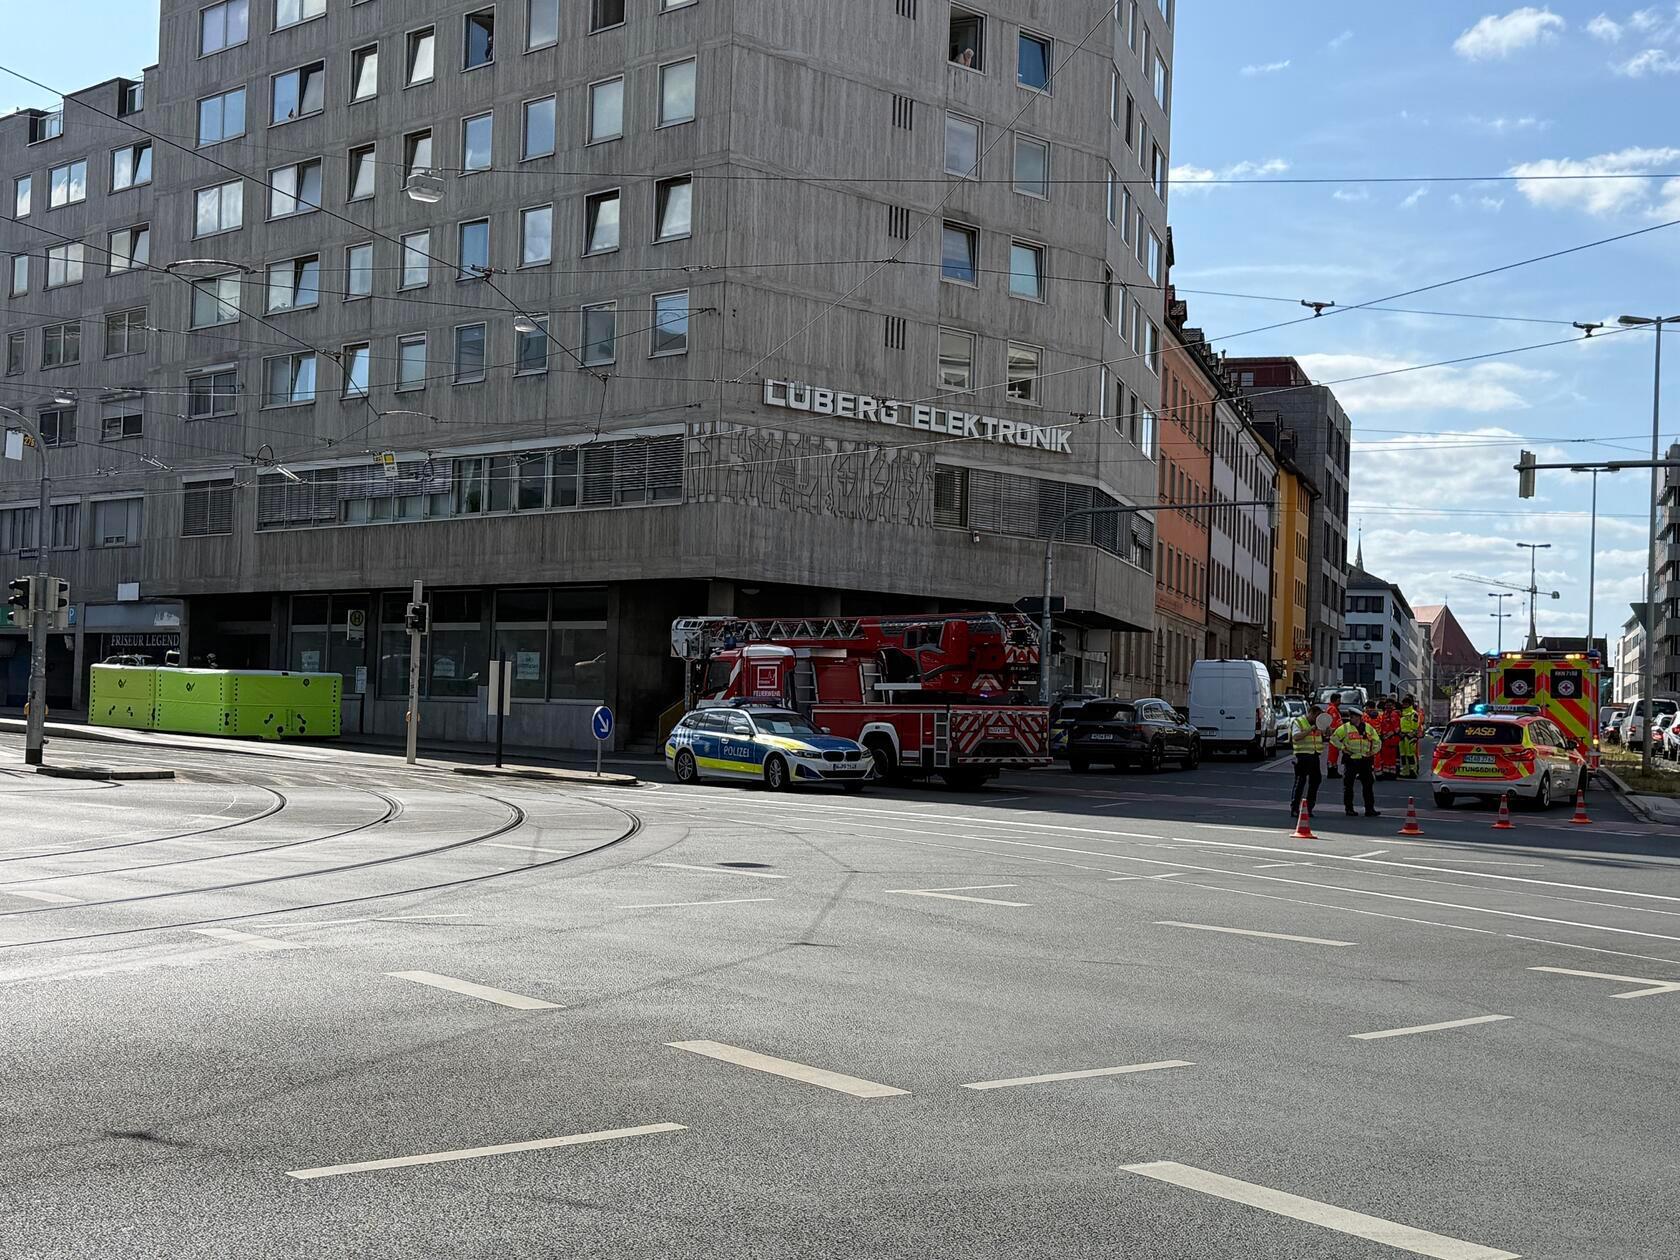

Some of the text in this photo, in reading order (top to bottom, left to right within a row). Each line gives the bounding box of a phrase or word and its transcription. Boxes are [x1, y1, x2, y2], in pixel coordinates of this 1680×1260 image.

[764, 378, 1073, 453] LÜBERG ELEKTRONIK
[111, 634, 144, 647] FRISEUR
[1474, 727, 1496, 736] ASB
[723, 745, 750, 758] POLIZEI
